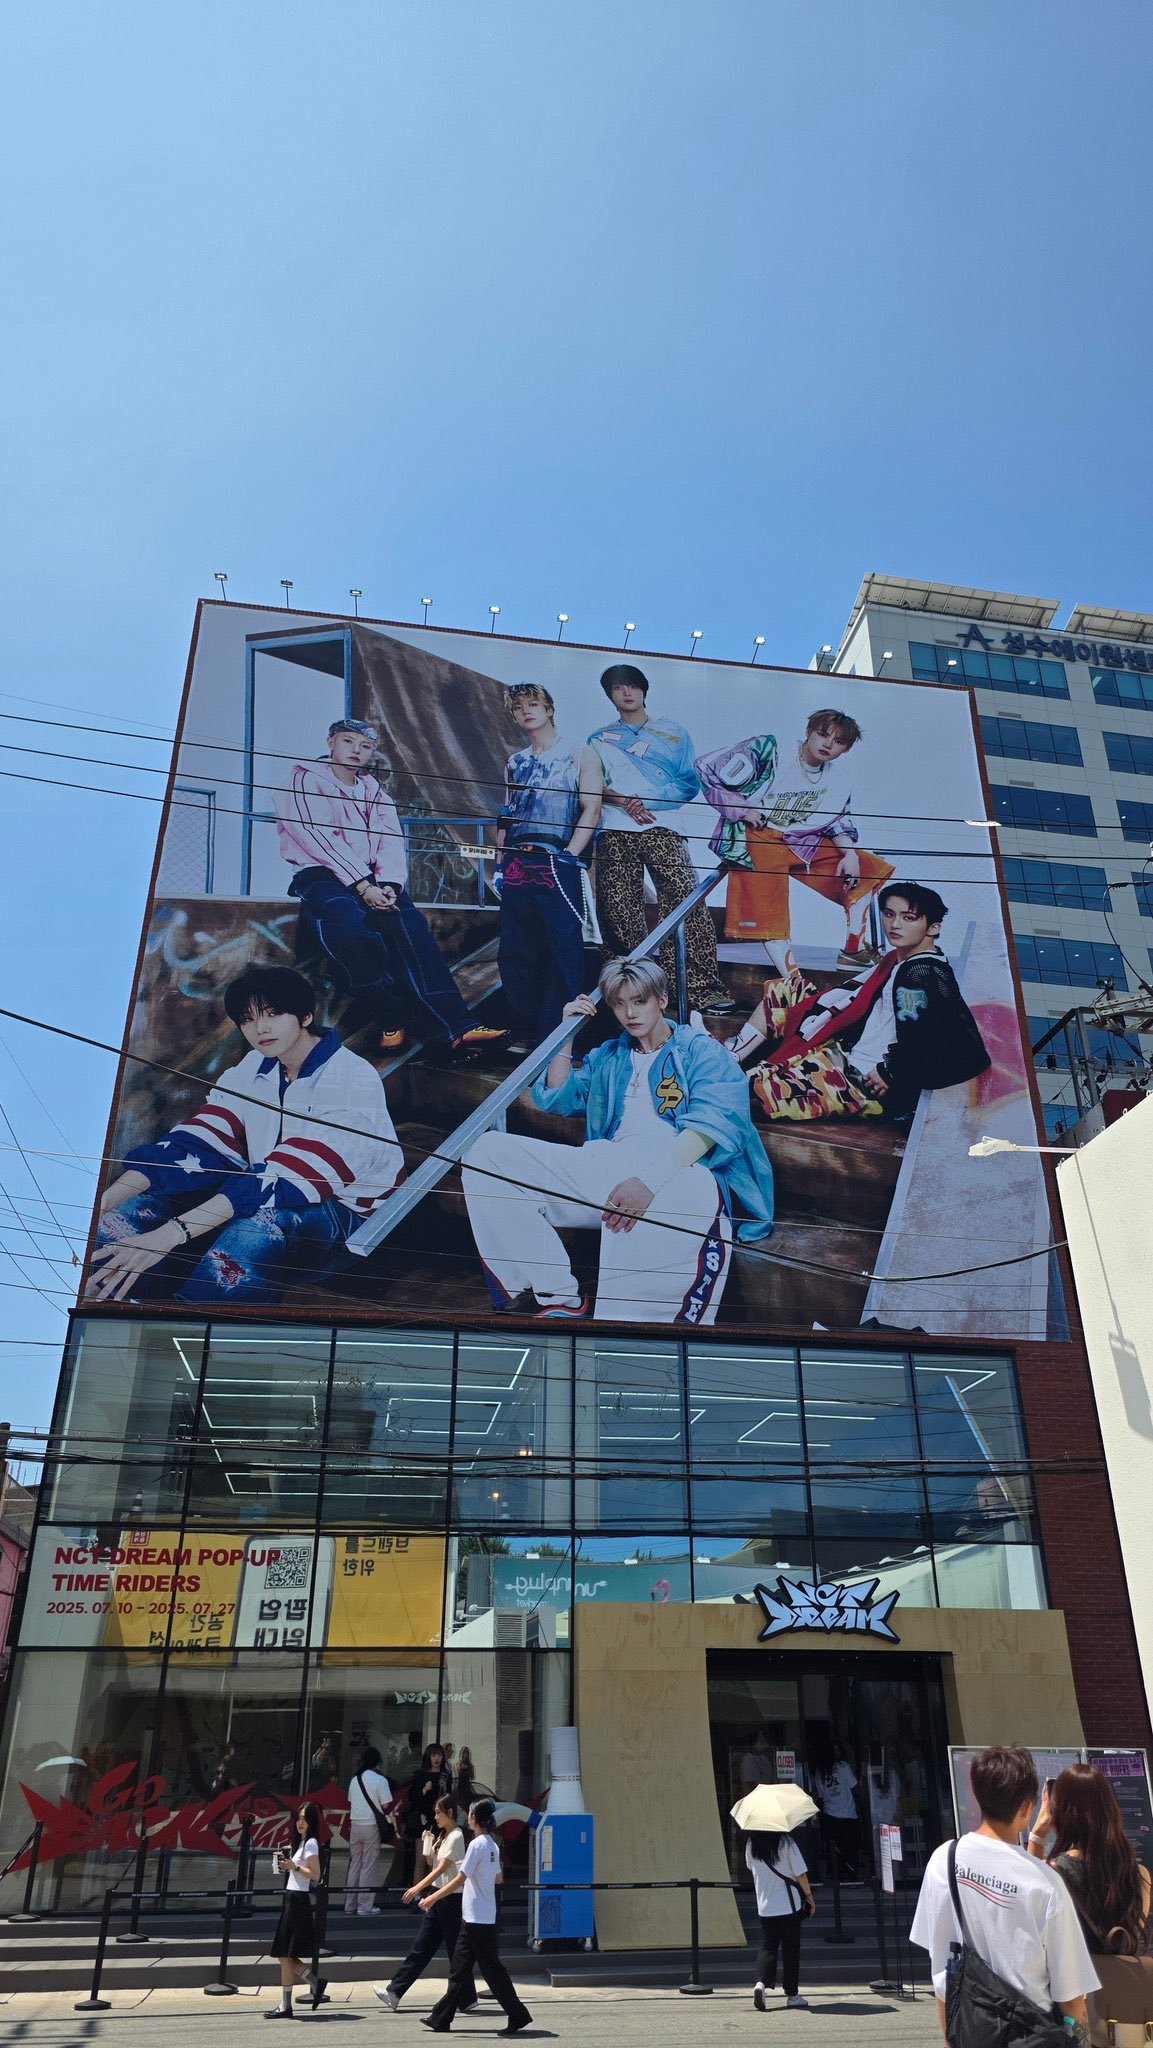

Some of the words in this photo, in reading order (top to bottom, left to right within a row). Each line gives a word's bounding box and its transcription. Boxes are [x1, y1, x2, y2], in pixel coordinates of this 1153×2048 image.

[1001, 632, 1153, 673] 성수에이원센
[54, 1547, 103, 1565] NCT
[109, 1547, 192, 1566] DREAM
[197, 1548, 281, 1567] POP-UP
[52, 1574, 110, 1592] TIME
[115, 1574, 201, 1593] RIDERS
[780, 1577, 880, 1607] NCT
[46, 1601, 88, 1614] 2025.
[118, 1602, 133, 1614] 10
[148, 1602, 188, 1615] 2025.
[218, 1603, 236, 1615] 27
